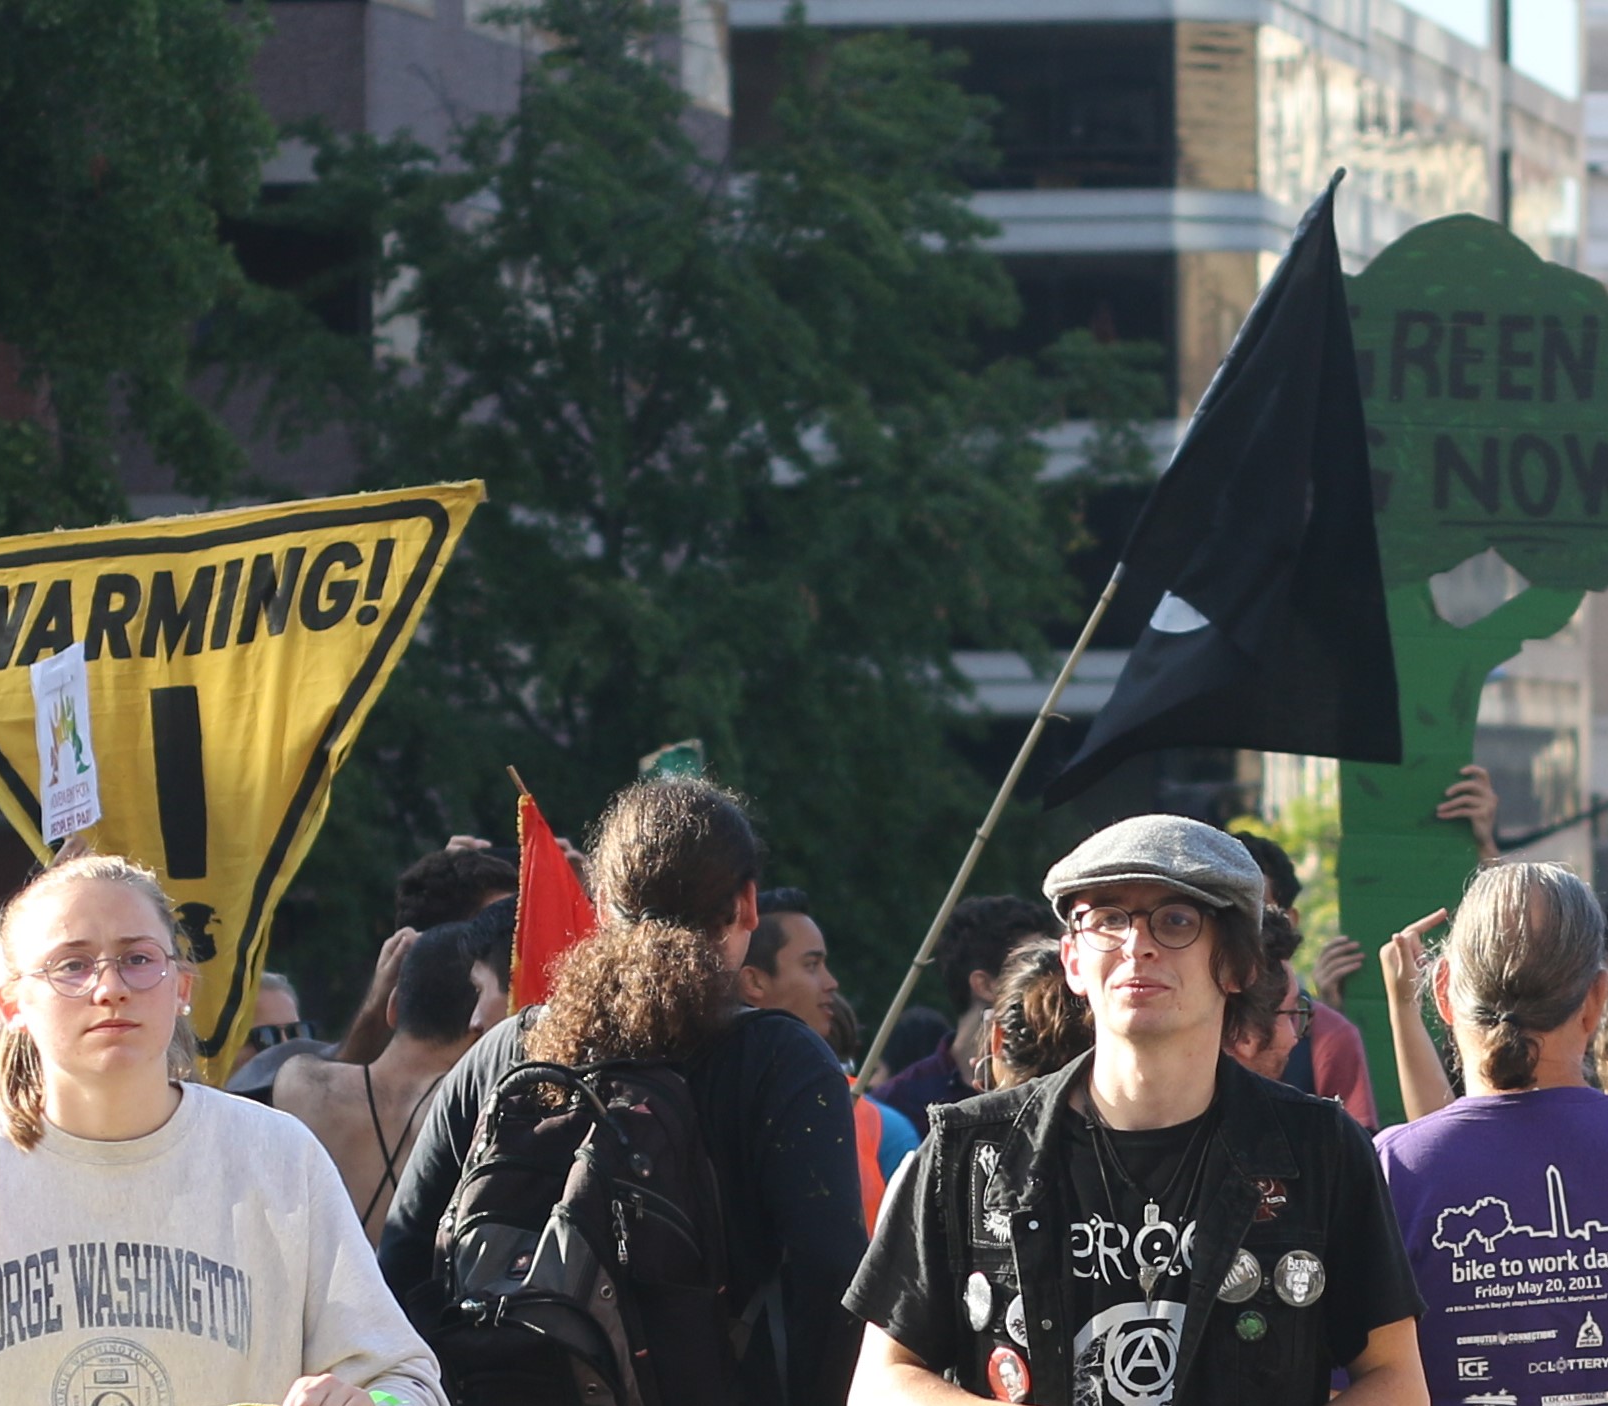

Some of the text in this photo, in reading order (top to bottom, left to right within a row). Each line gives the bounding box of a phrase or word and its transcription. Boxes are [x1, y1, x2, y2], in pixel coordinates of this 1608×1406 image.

[1452, 1259, 1495, 1283] bike
[1500, 1256, 1523, 1277] to
[1528, 1249, 1580, 1274] work
[1475, 1275, 1603, 1299] Friday May 20, 2011
[68, 1241, 254, 1360] WASHINGTON
[1456, 1334, 1497, 1346] COMMUTER
[1457, 1358, 1489, 1377] ICF
